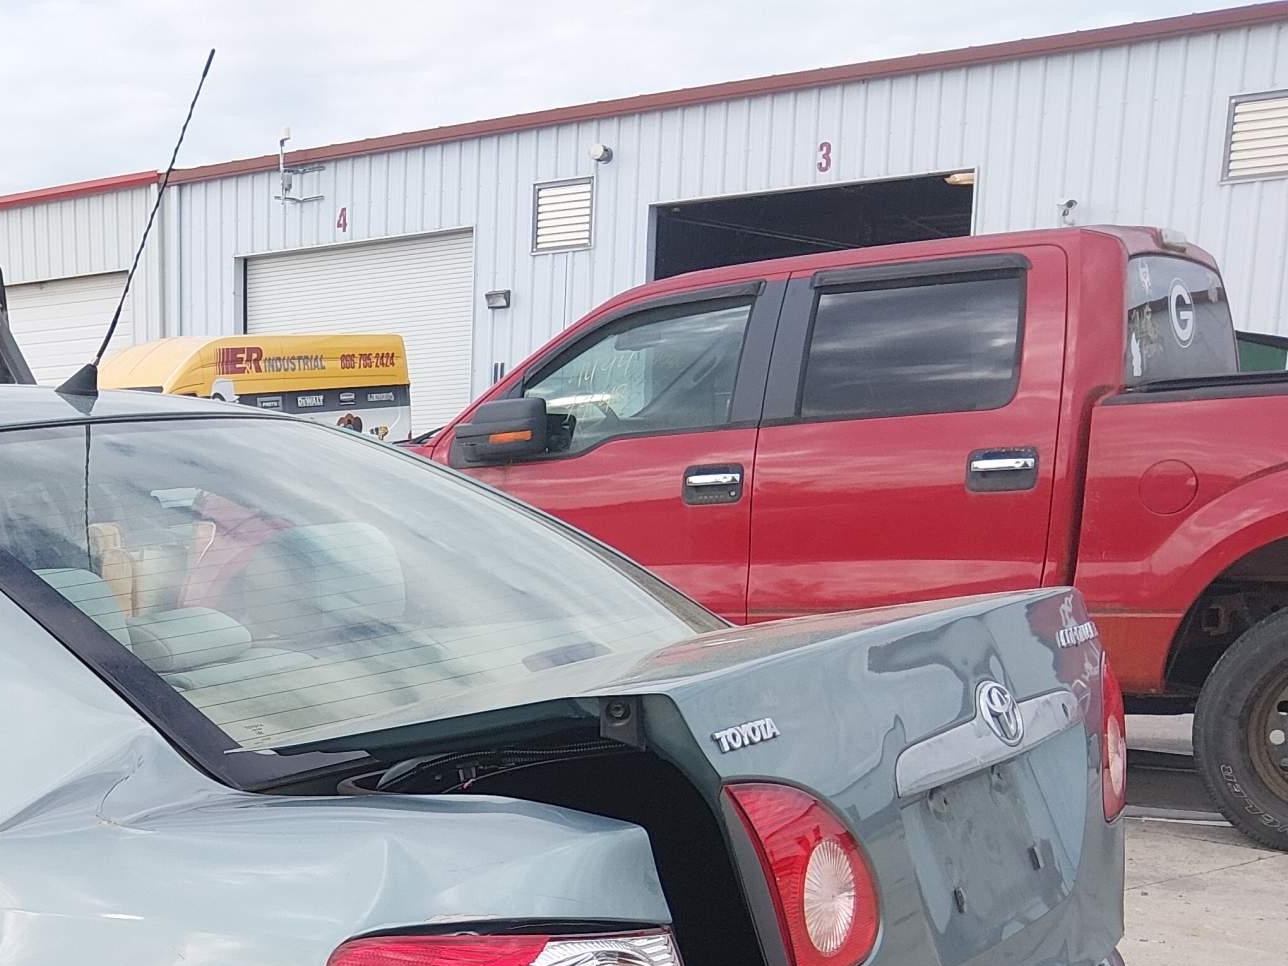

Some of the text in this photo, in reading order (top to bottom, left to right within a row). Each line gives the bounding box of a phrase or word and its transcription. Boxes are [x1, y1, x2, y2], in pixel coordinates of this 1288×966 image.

[817, 142, 831, 172] 3
[337, 208, 347, 232] 4
[264, 354, 326, 373] INDUSTRIAL
[712, 717, 781, 753] TOYOTA
